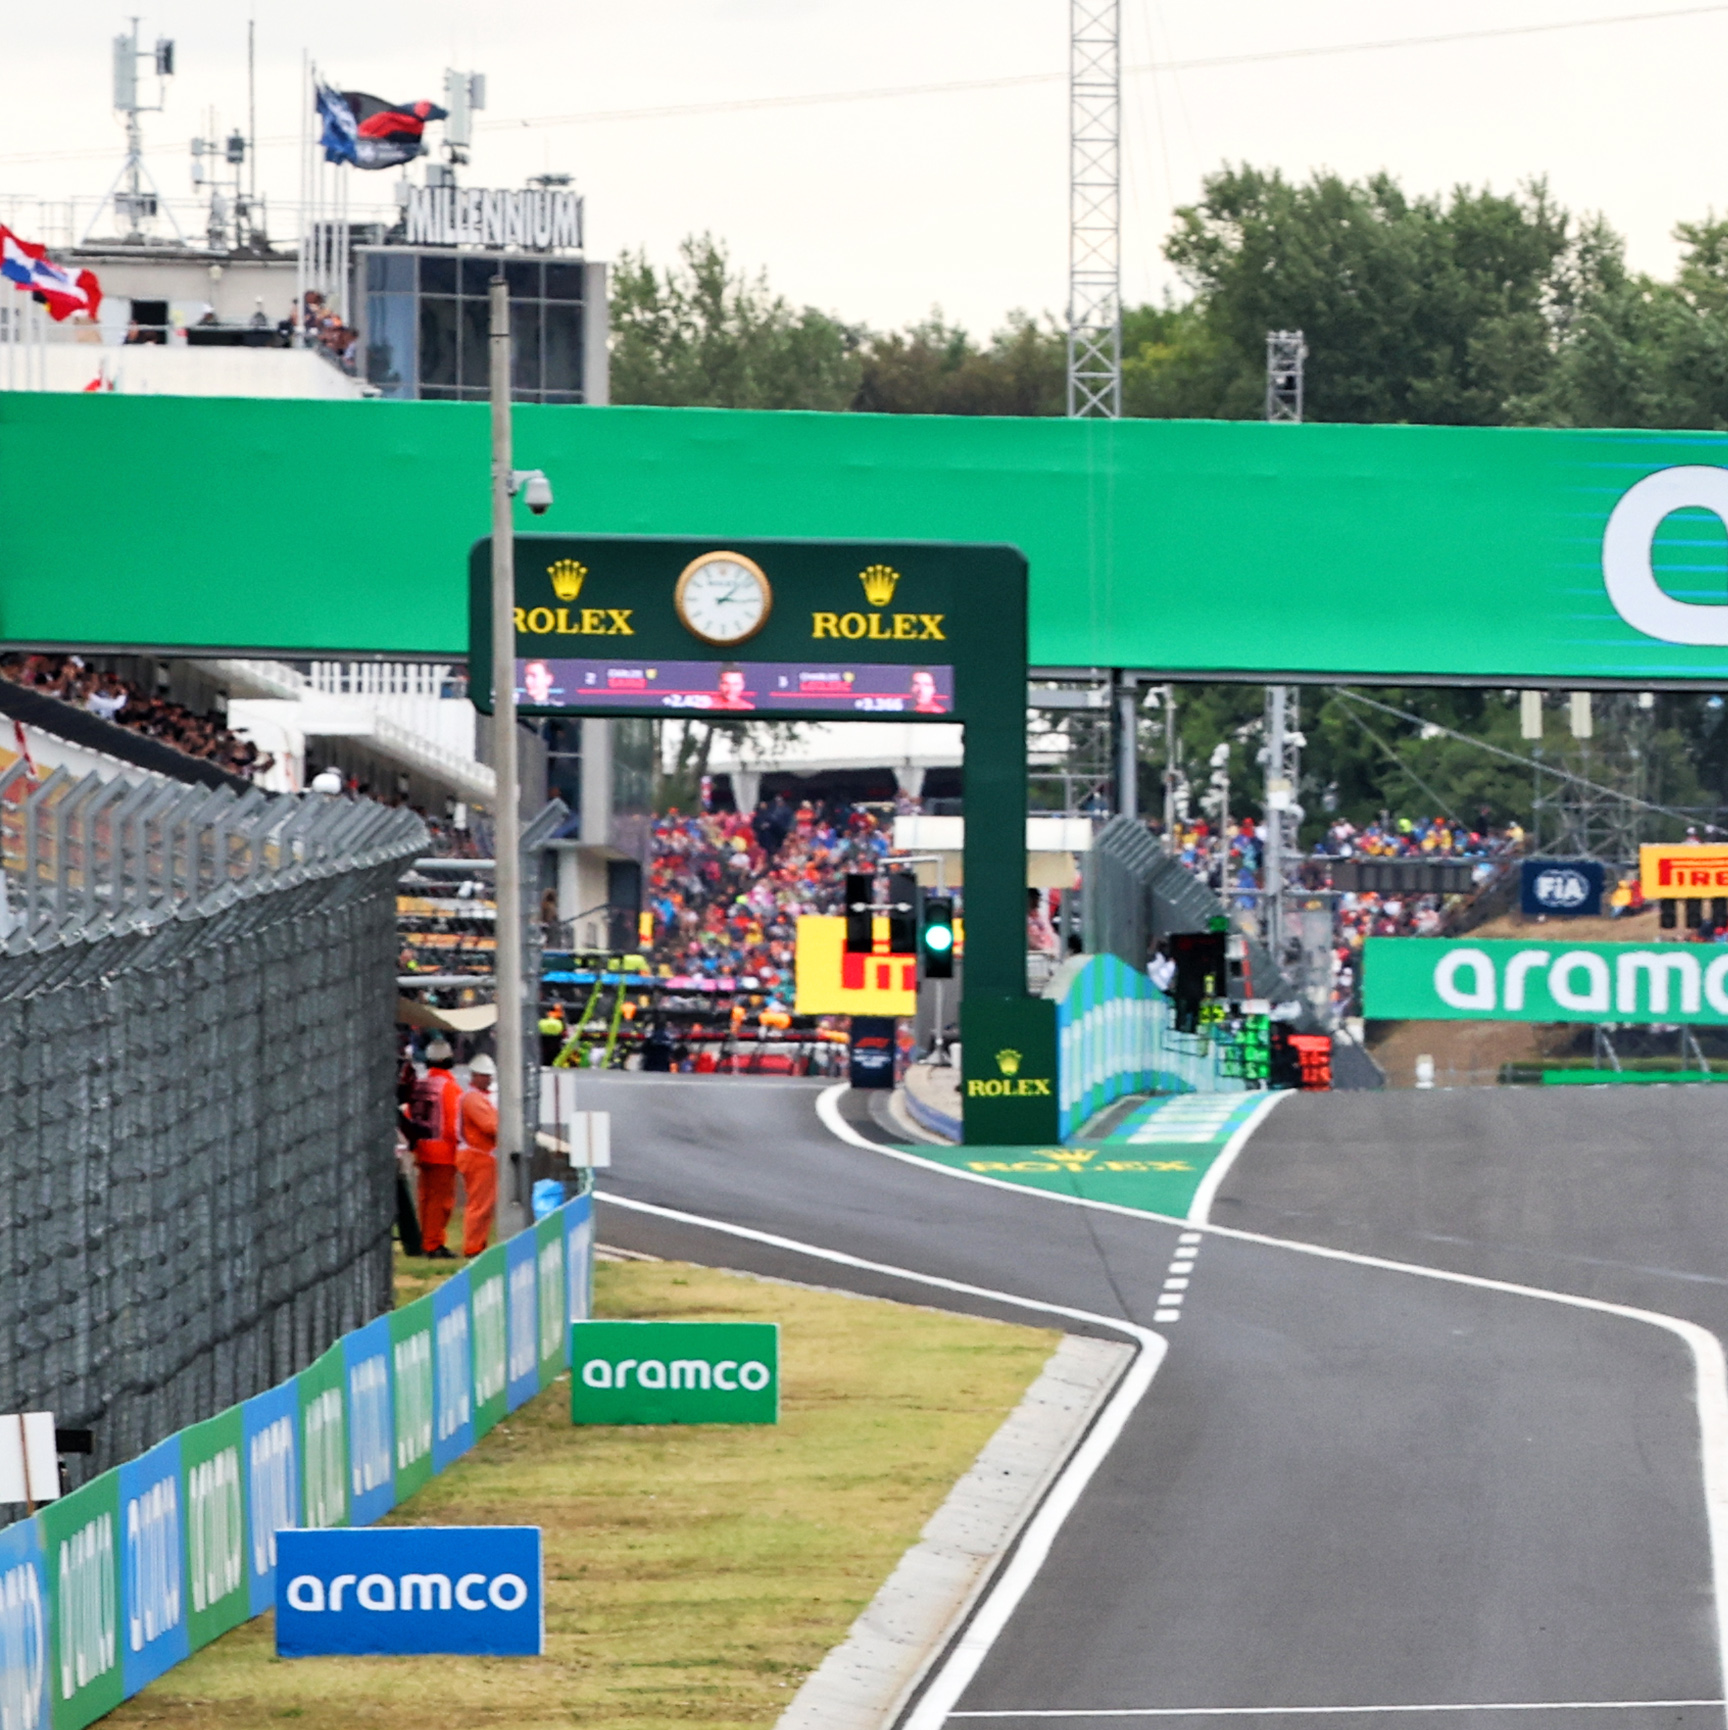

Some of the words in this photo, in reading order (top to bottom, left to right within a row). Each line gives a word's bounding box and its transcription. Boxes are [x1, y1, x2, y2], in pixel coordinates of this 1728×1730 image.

[407, 187, 580, 247] MILLENNIUM
[811, 611, 947, 640] ROLEX
[967, 1079, 1052, 1097] ROLEX
[582, 1359, 770, 1391] aramco
[287, 1573, 528, 1612] aramco
